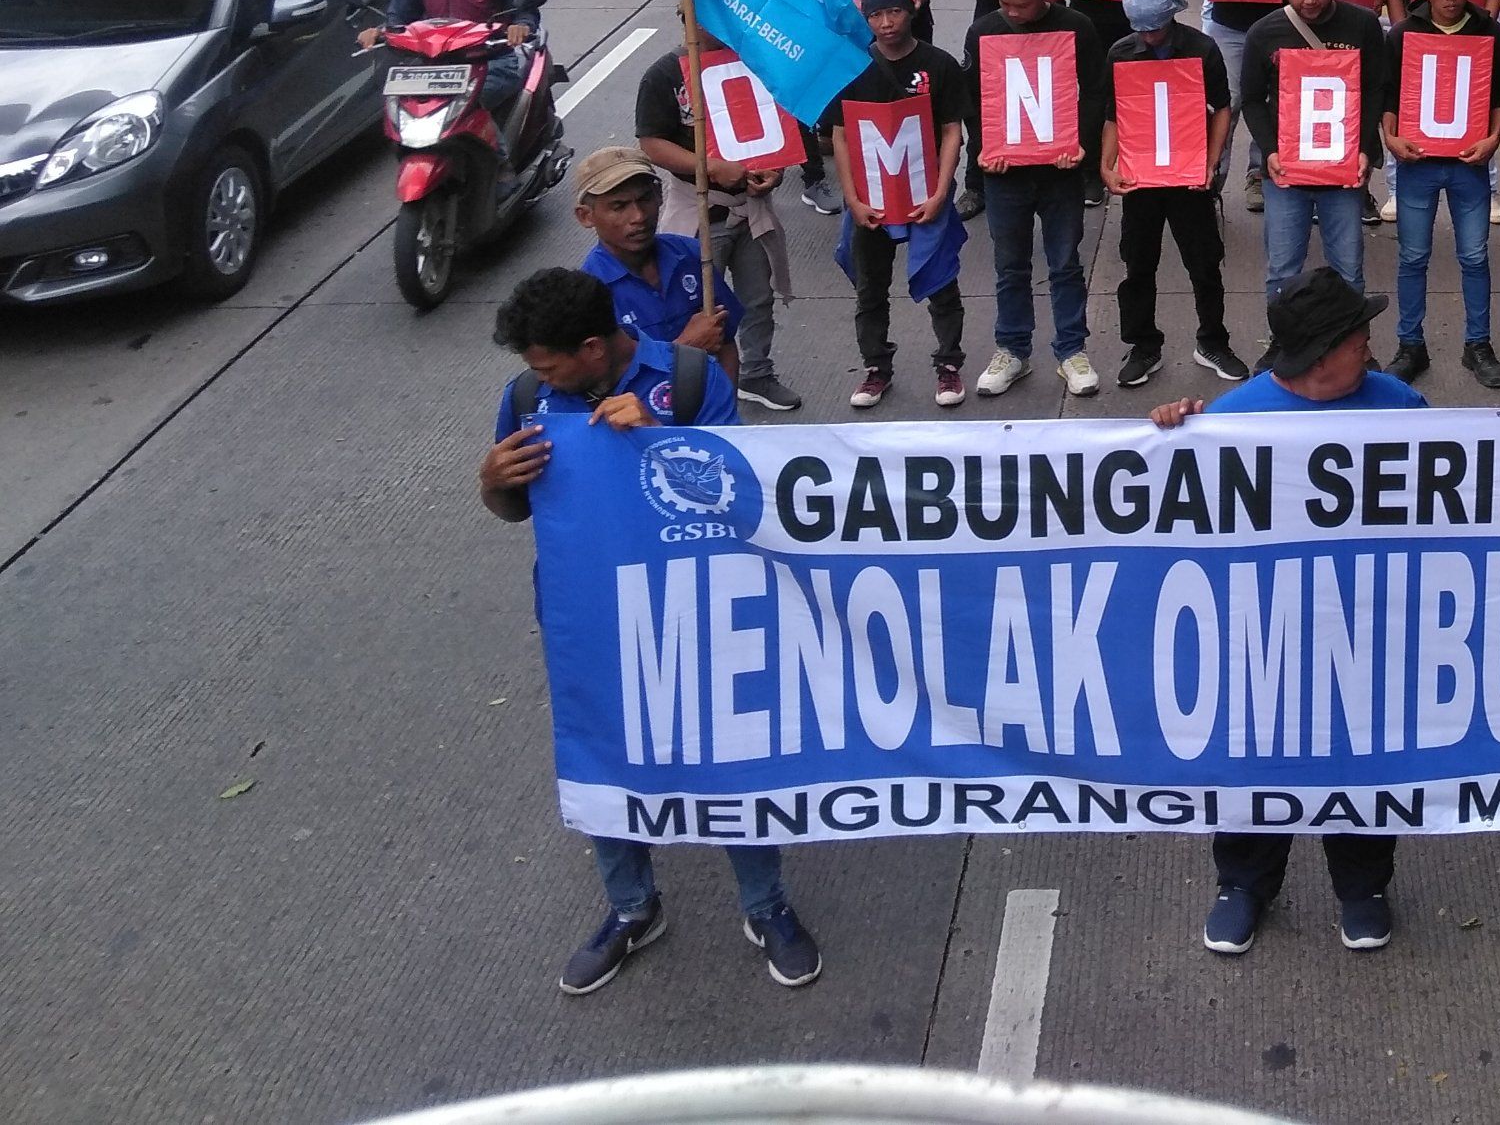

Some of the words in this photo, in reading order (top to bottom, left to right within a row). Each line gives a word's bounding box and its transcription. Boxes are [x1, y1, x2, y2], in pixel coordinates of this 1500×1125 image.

[702, 60, 786, 162] O
[1005, 56, 1054, 145] N
[1154, 81, 1171, 167] I
[1299, 76, 1347, 162] B
[1419, 54, 1472, 140] U
[859, 114, 929, 211] M
[660, 522, 738, 543] GSBI
[775, 446, 1273, 543] GABUNGAN
[617, 554, 1122, 767] MENOLAK
[626, 781, 1217, 839] MENGURANGI
[1253, 788, 1425, 829] DAN
